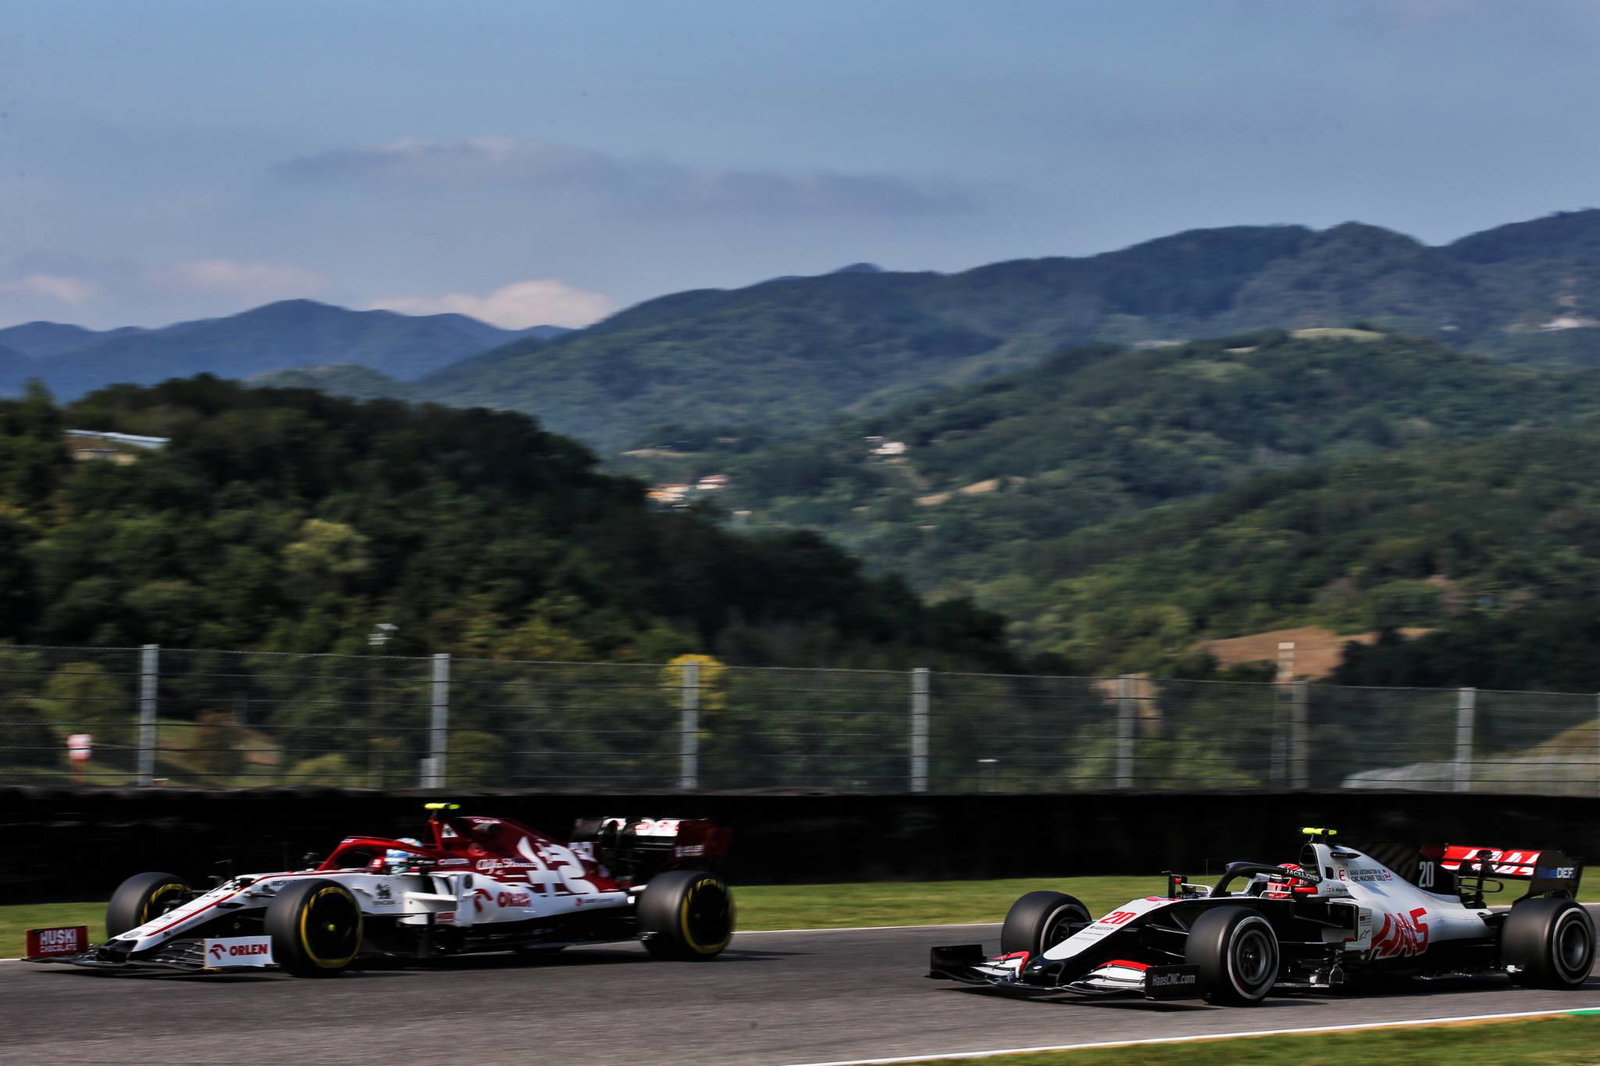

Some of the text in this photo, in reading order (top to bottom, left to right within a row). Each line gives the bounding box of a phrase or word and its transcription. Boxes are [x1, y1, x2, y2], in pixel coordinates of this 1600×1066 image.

[1419, 861, 1434, 888] 20
[1099, 911, 1137, 925] 20
[40, 929, 77, 945] HUSKI
[229, 943, 268, 956] ORLEN
[1152, 973, 1196, 986] HaasCNC.com
